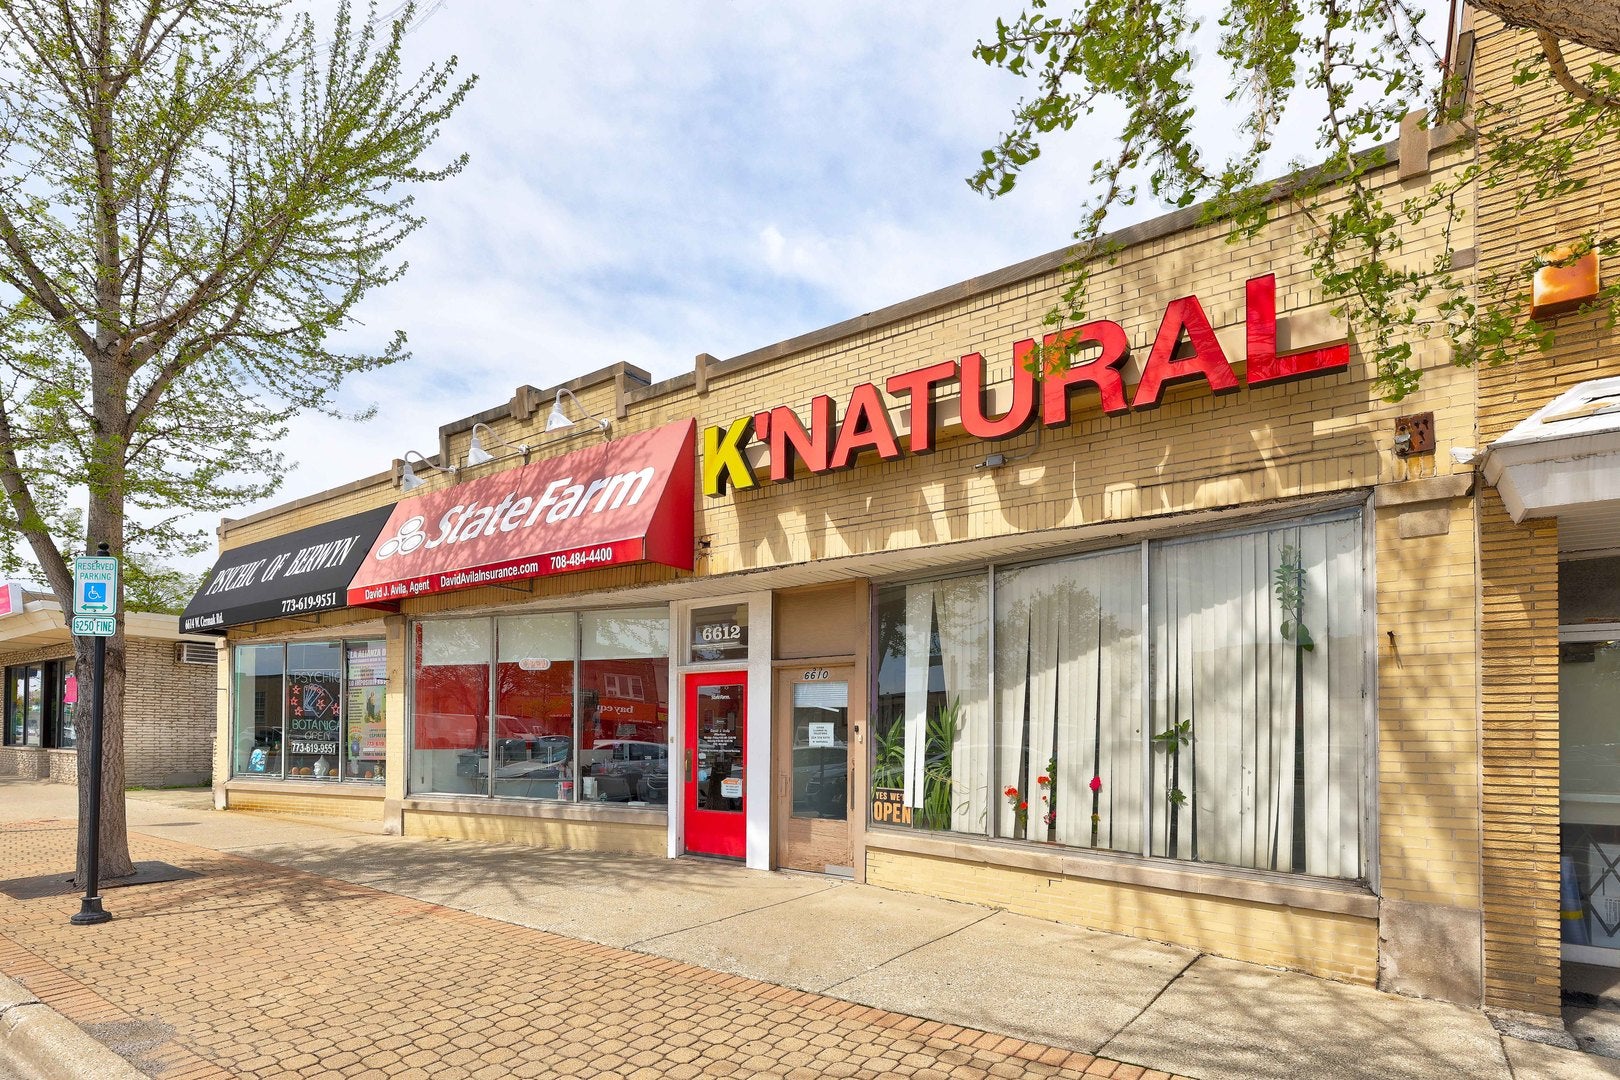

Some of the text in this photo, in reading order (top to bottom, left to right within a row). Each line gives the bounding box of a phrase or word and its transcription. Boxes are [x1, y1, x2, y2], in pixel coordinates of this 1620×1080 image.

[703, 272, 1350, 497] K'NATURAL
[77, 562, 114, 570] RESERVED
[205, 535, 360, 596] PSYCHIC OF BERWYN
[550, 546, 612, 570] 708-484-4400
[80, 572, 111, 580] PARKING
[440, 560, 539, 588] DavidAvilaInsurance.com
[364, 579, 430, 600] David J. Avila, Agent
[281, 592, 336, 613] 773-619-9551
[75, 620, 113, 631] $250 FINE
[200, 613, 215, 627] Cermak
[216, 611, 224, 624] Rd.
[702, 625, 741, 641] 6612
[293, 671, 340, 683] PSYCHIC
[804, 670, 829, 680] 6610
[292, 742, 336, 754] 773-619-9551
[875, 791, 888, 800] YES
[873, 800, 911, 824] OPEN
